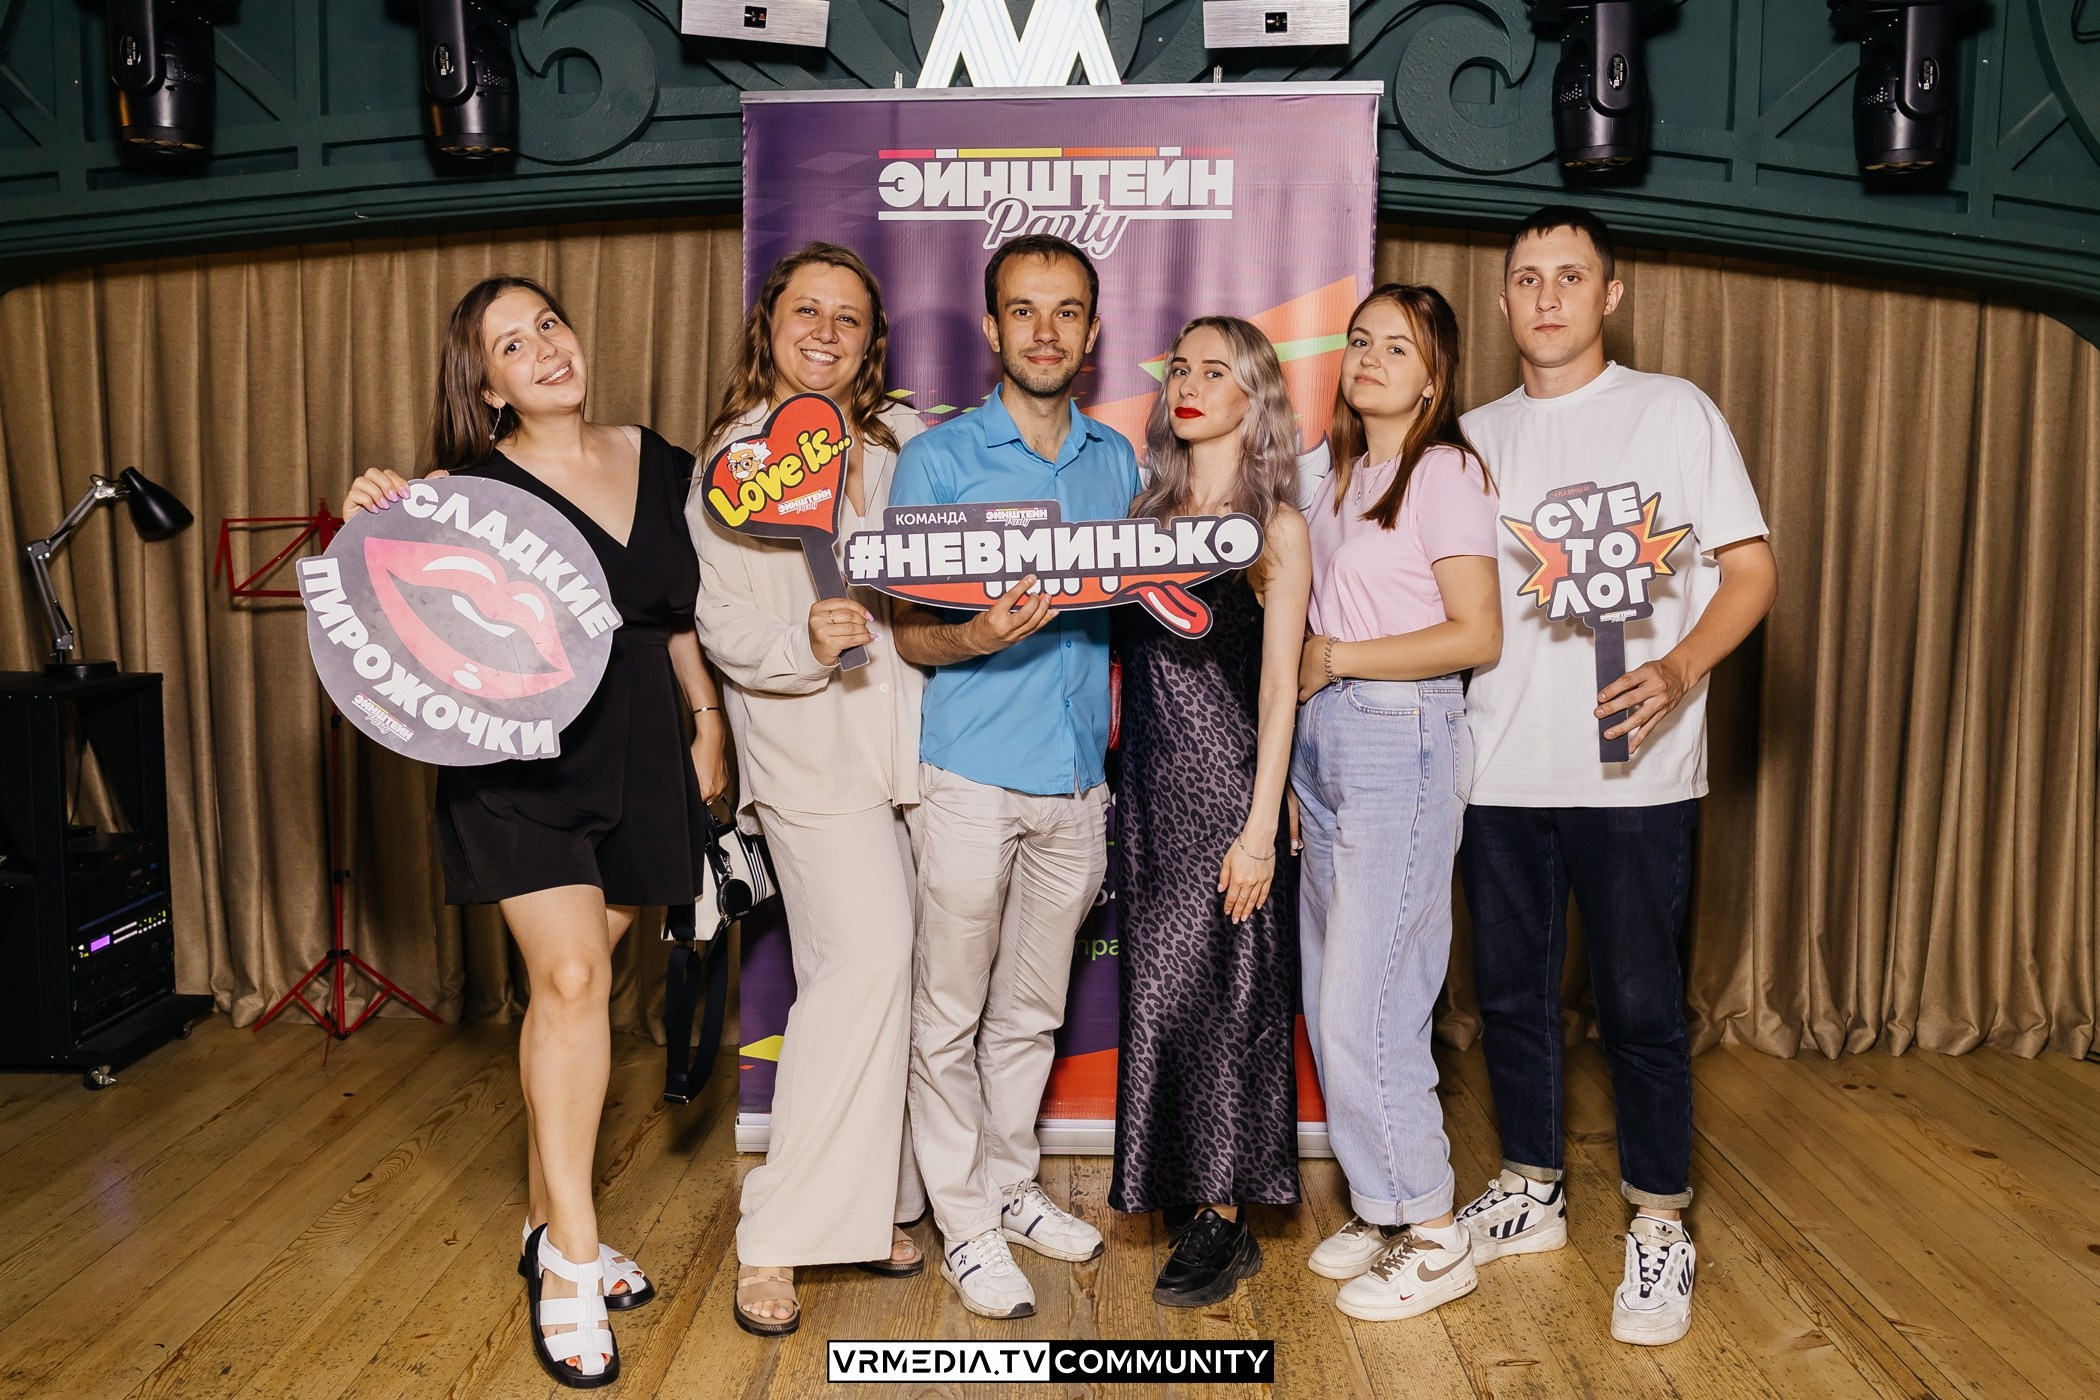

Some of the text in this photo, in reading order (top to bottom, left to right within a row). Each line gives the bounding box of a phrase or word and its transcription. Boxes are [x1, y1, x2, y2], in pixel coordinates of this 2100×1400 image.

[879, 147, 1234, 207] ЭЙНШТЕЙН
[983, 198, 1130, 259] Party
[707, 454, 804, 528] Love
[985, 507, 1047, 521] ЭЙНШТЕЙН
[1536, 486, 1641, 539] СУЕ
[1554, 485, 1590, 498] ГЛАВНЫЙ
[895, 511, 968, 526] КОМАНДА
[402, 483, 619, 639] СЛАДКИЕ
[849, 518, 1260, 579] #НЕВМИНЬКО
[1565, 531, 1637, 573] ТО
[1550, 566, 1652, 618] ЛОГ
[301, 557, 556, 756] ПИРОЖОЧКИ
[354, 694, 414, 741] ЭЙНШТЕЙН
